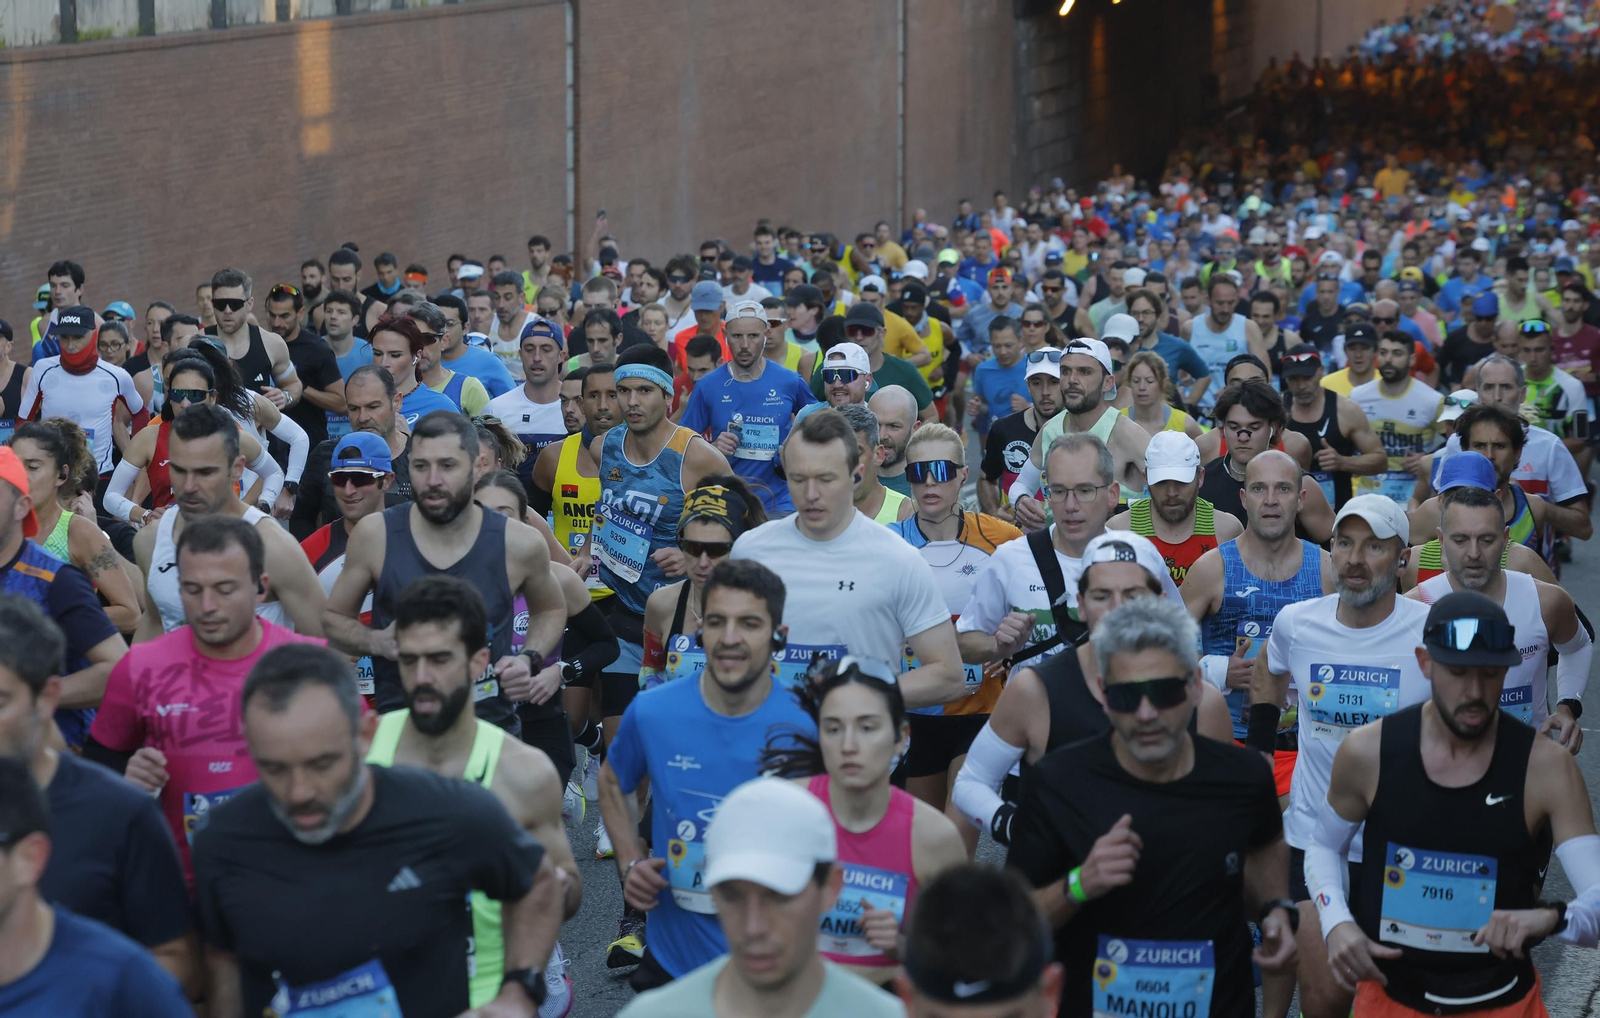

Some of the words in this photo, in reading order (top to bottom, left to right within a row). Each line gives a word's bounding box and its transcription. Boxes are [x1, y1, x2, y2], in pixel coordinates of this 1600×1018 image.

[60, 315, 81, 325] HOKA
[745, 416, 774, 424] ZURICH
[572, 519, 593, 529] GIL
[612, 513, 647, 536] ZURICH
[609, 530, 627, 546] 5339
[609, 547, 643, 572] CARDOSO
[790, 649, 838, 660] ZURCH
[1520, 644, 1538, 655] DIJON
[1339, 669, 1389, 684] ZURICH
[1338, 694, 1363, 706] 5131
[1334, 711, 1370, 726] ALEX
[1422, 856, 1484, 875] ZURICH
[1422, 885, 1454, 901] 7916
[1135, 948, 1201, 965] ZURICH
[297, 972, 375, 1009] ZURICH
[1136, 980, 1170, 994] 6604
[1106, 994, 1197, 1018] MANOLO
